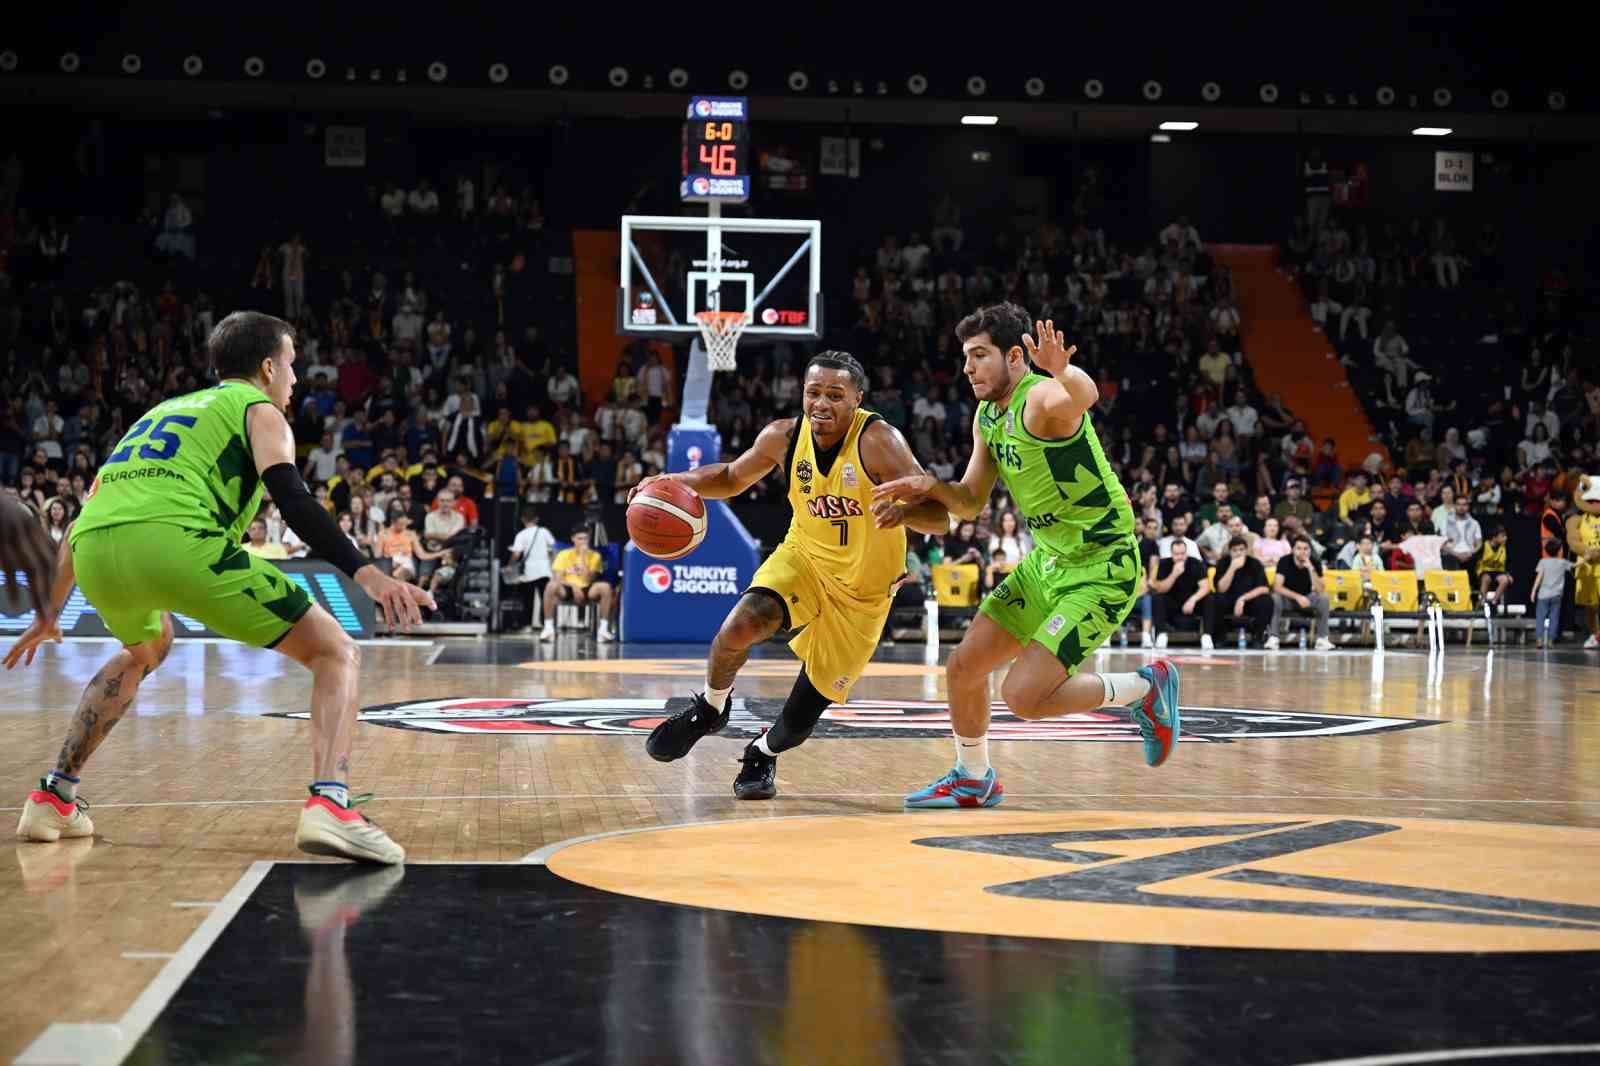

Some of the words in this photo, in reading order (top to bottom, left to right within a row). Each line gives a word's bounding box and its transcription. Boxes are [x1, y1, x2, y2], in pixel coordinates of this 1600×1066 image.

[699, 144, 737, 176] 46
[779, 310, 806, 325] TBF
[105, 414, 198, 464] 25
[807, 494, 864, 519] MSK
[830, 519, 849, 546] 7
